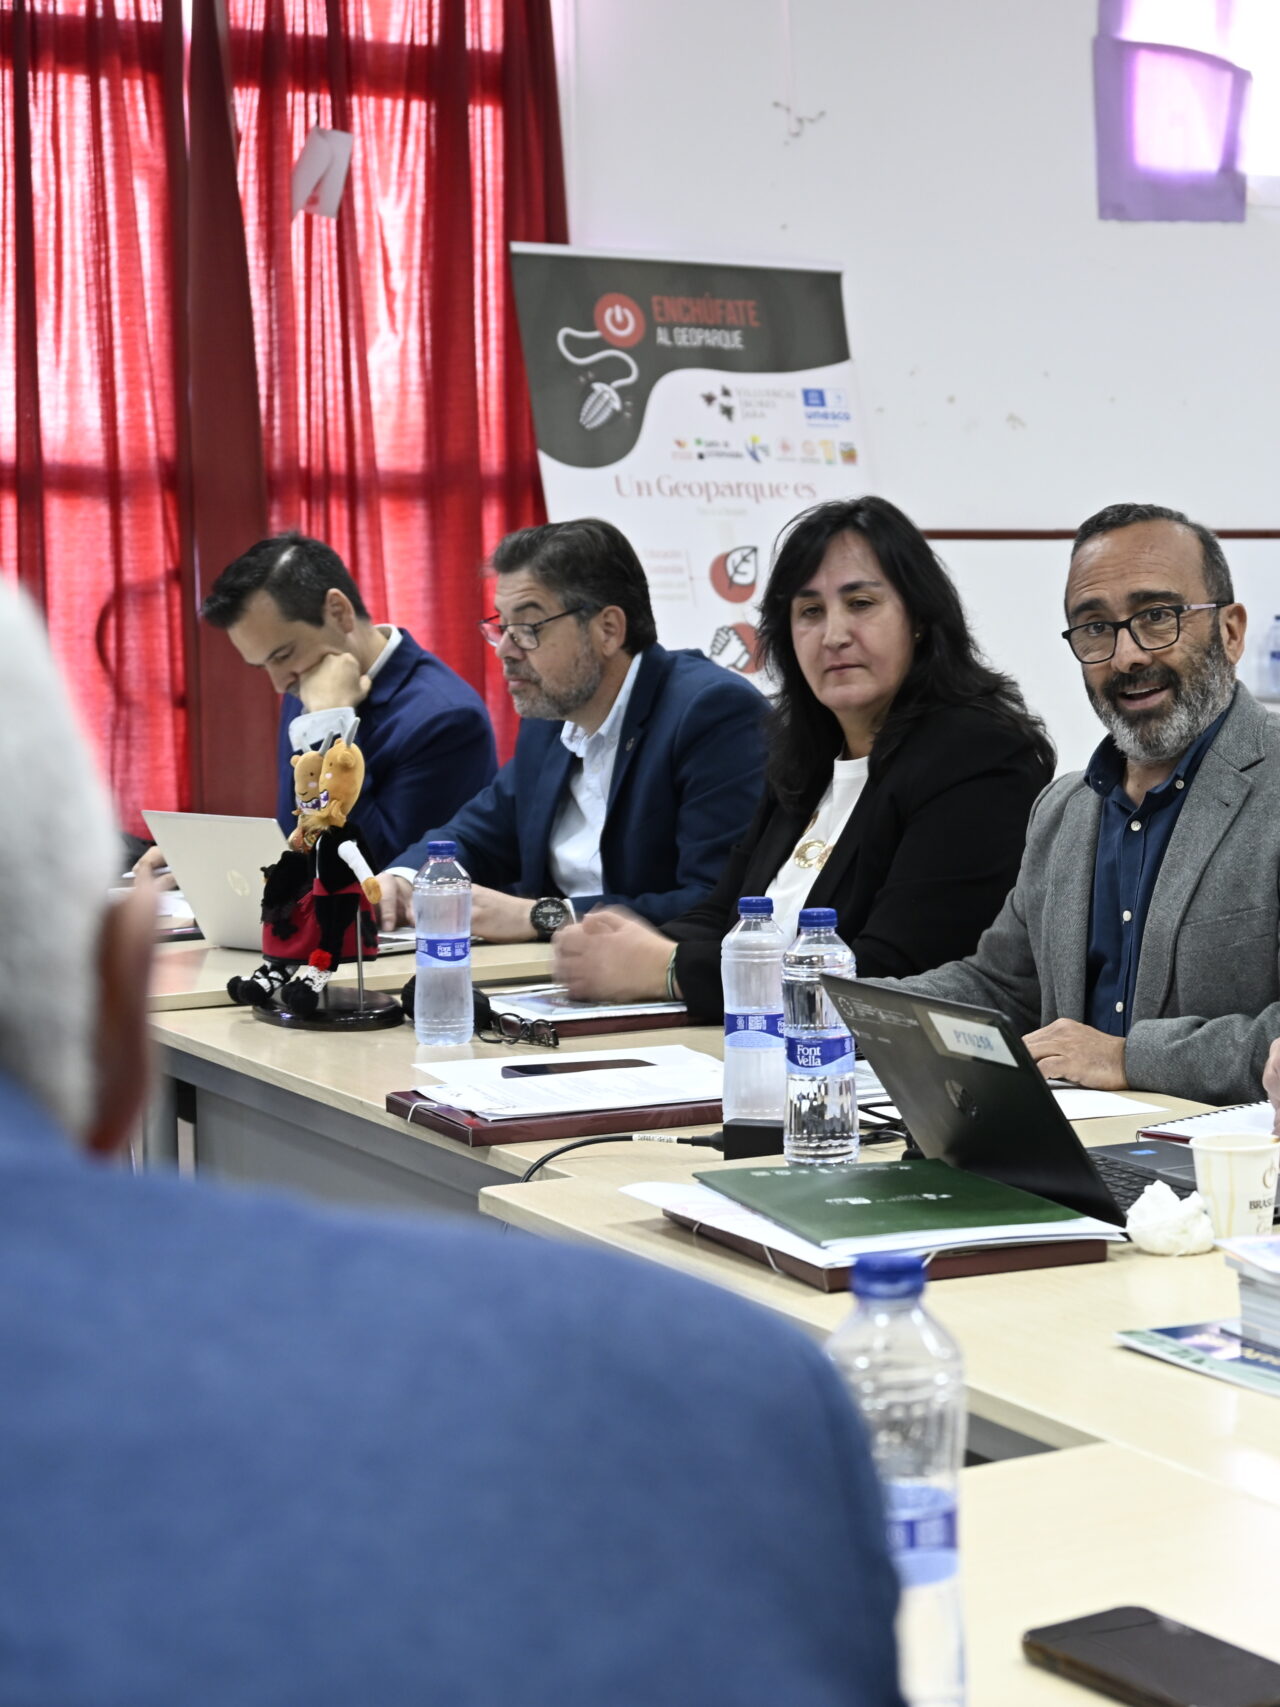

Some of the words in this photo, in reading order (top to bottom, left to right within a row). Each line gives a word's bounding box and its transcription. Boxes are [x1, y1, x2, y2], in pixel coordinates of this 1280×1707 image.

[651, 292, 761, 328] ENCHÚFATE
[656, 326, 672, 347] AL
[673, 327, 745, 350] GEOPARQUE
[614, 474, 652, 498] Un
[655, 474, 789, 503] Geoparque
[793, 481, 817, 498] es
[796, 1044, 822, 1056] Font
[796, 1055, 822, 1067] Vella
